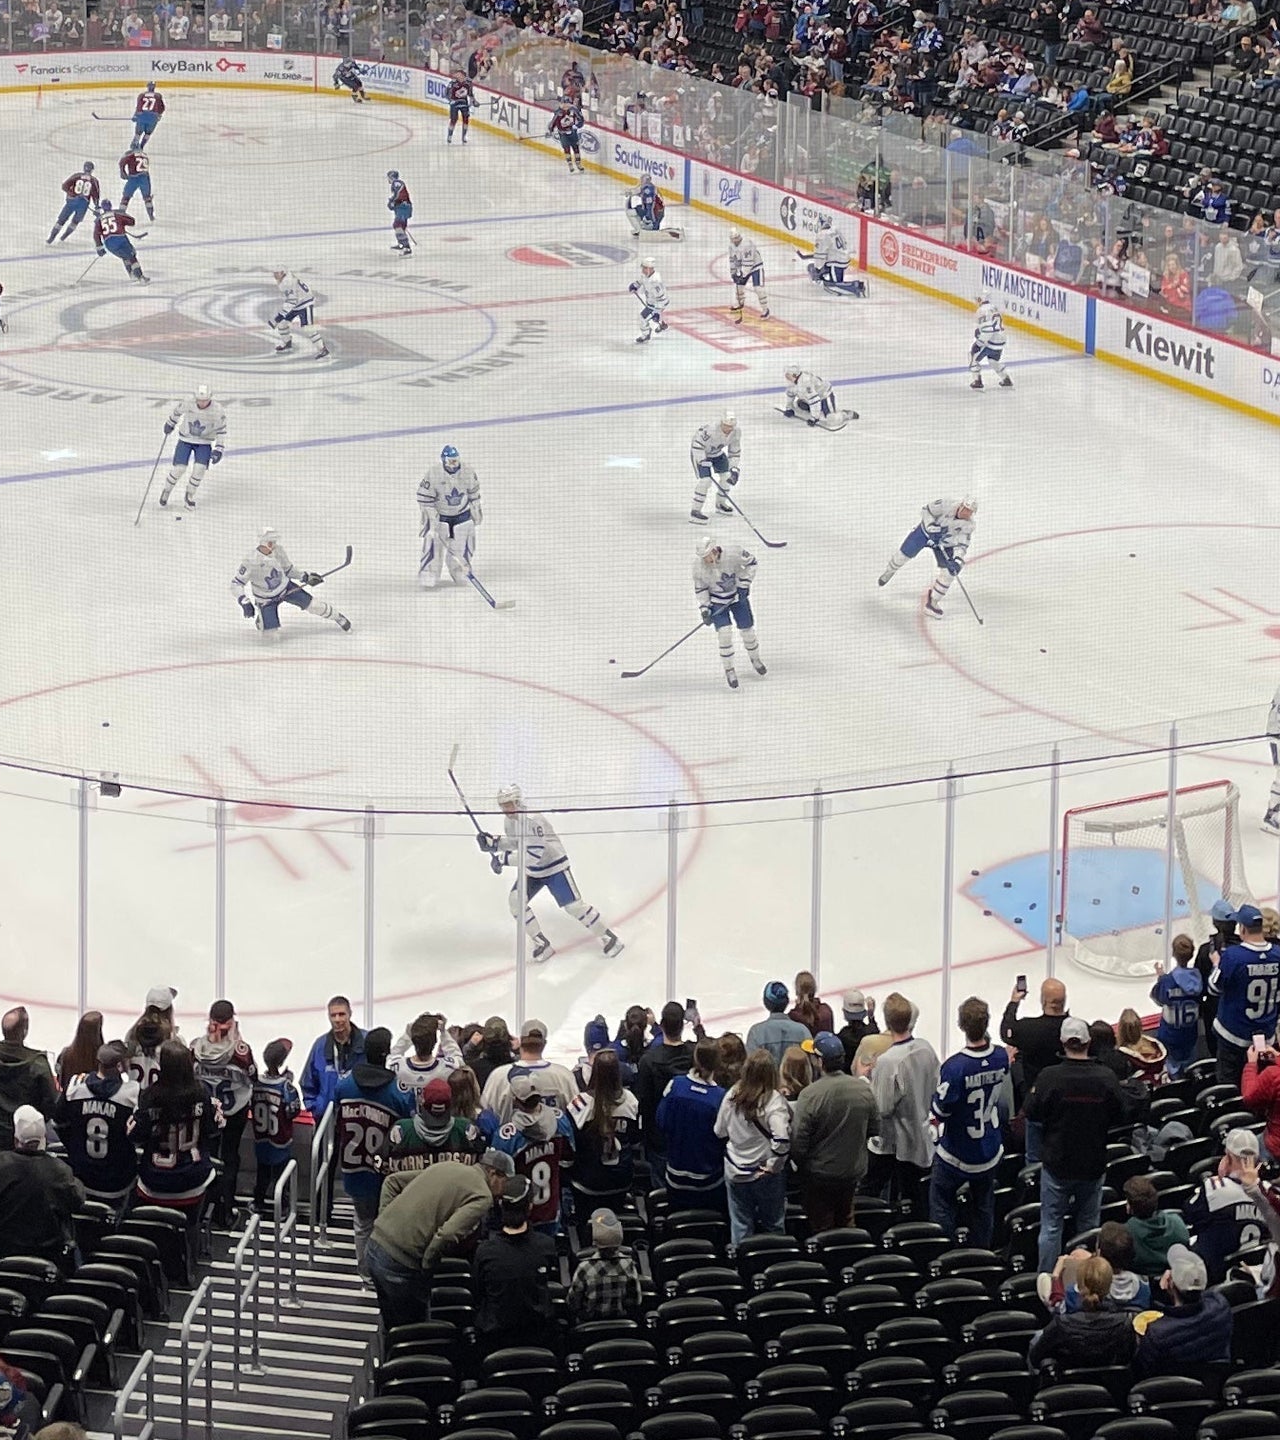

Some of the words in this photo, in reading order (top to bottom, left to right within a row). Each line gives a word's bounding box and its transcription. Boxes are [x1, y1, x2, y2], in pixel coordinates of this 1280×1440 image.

[30, 62, 71, 76] Fanatics
[72, 62, 131, 76] Sportsbook
[151, 59, 213, 74] KeyBank
[141, 97, 156, 111] 27
[490, 95, 530, 133] PATH
[614, 143, 670, 180] Southwest
[73, 179, 91, 197] 88
[100, 217, 118, 235] 55
[981, 264, 1002, 289] NEW
[1003, 273, 1067, 313] AMSTERDAM
[1004, 300, 1041, 321] VODKA
[1124, 317, 1215, 379] Kiewit
[1245, 978, 1279, 1021] 91
[81, 1100, 117, 1119] MAKAR
[966, 1088, 1000, 1139] 34
[86, 1117, 110, 1160] 8
